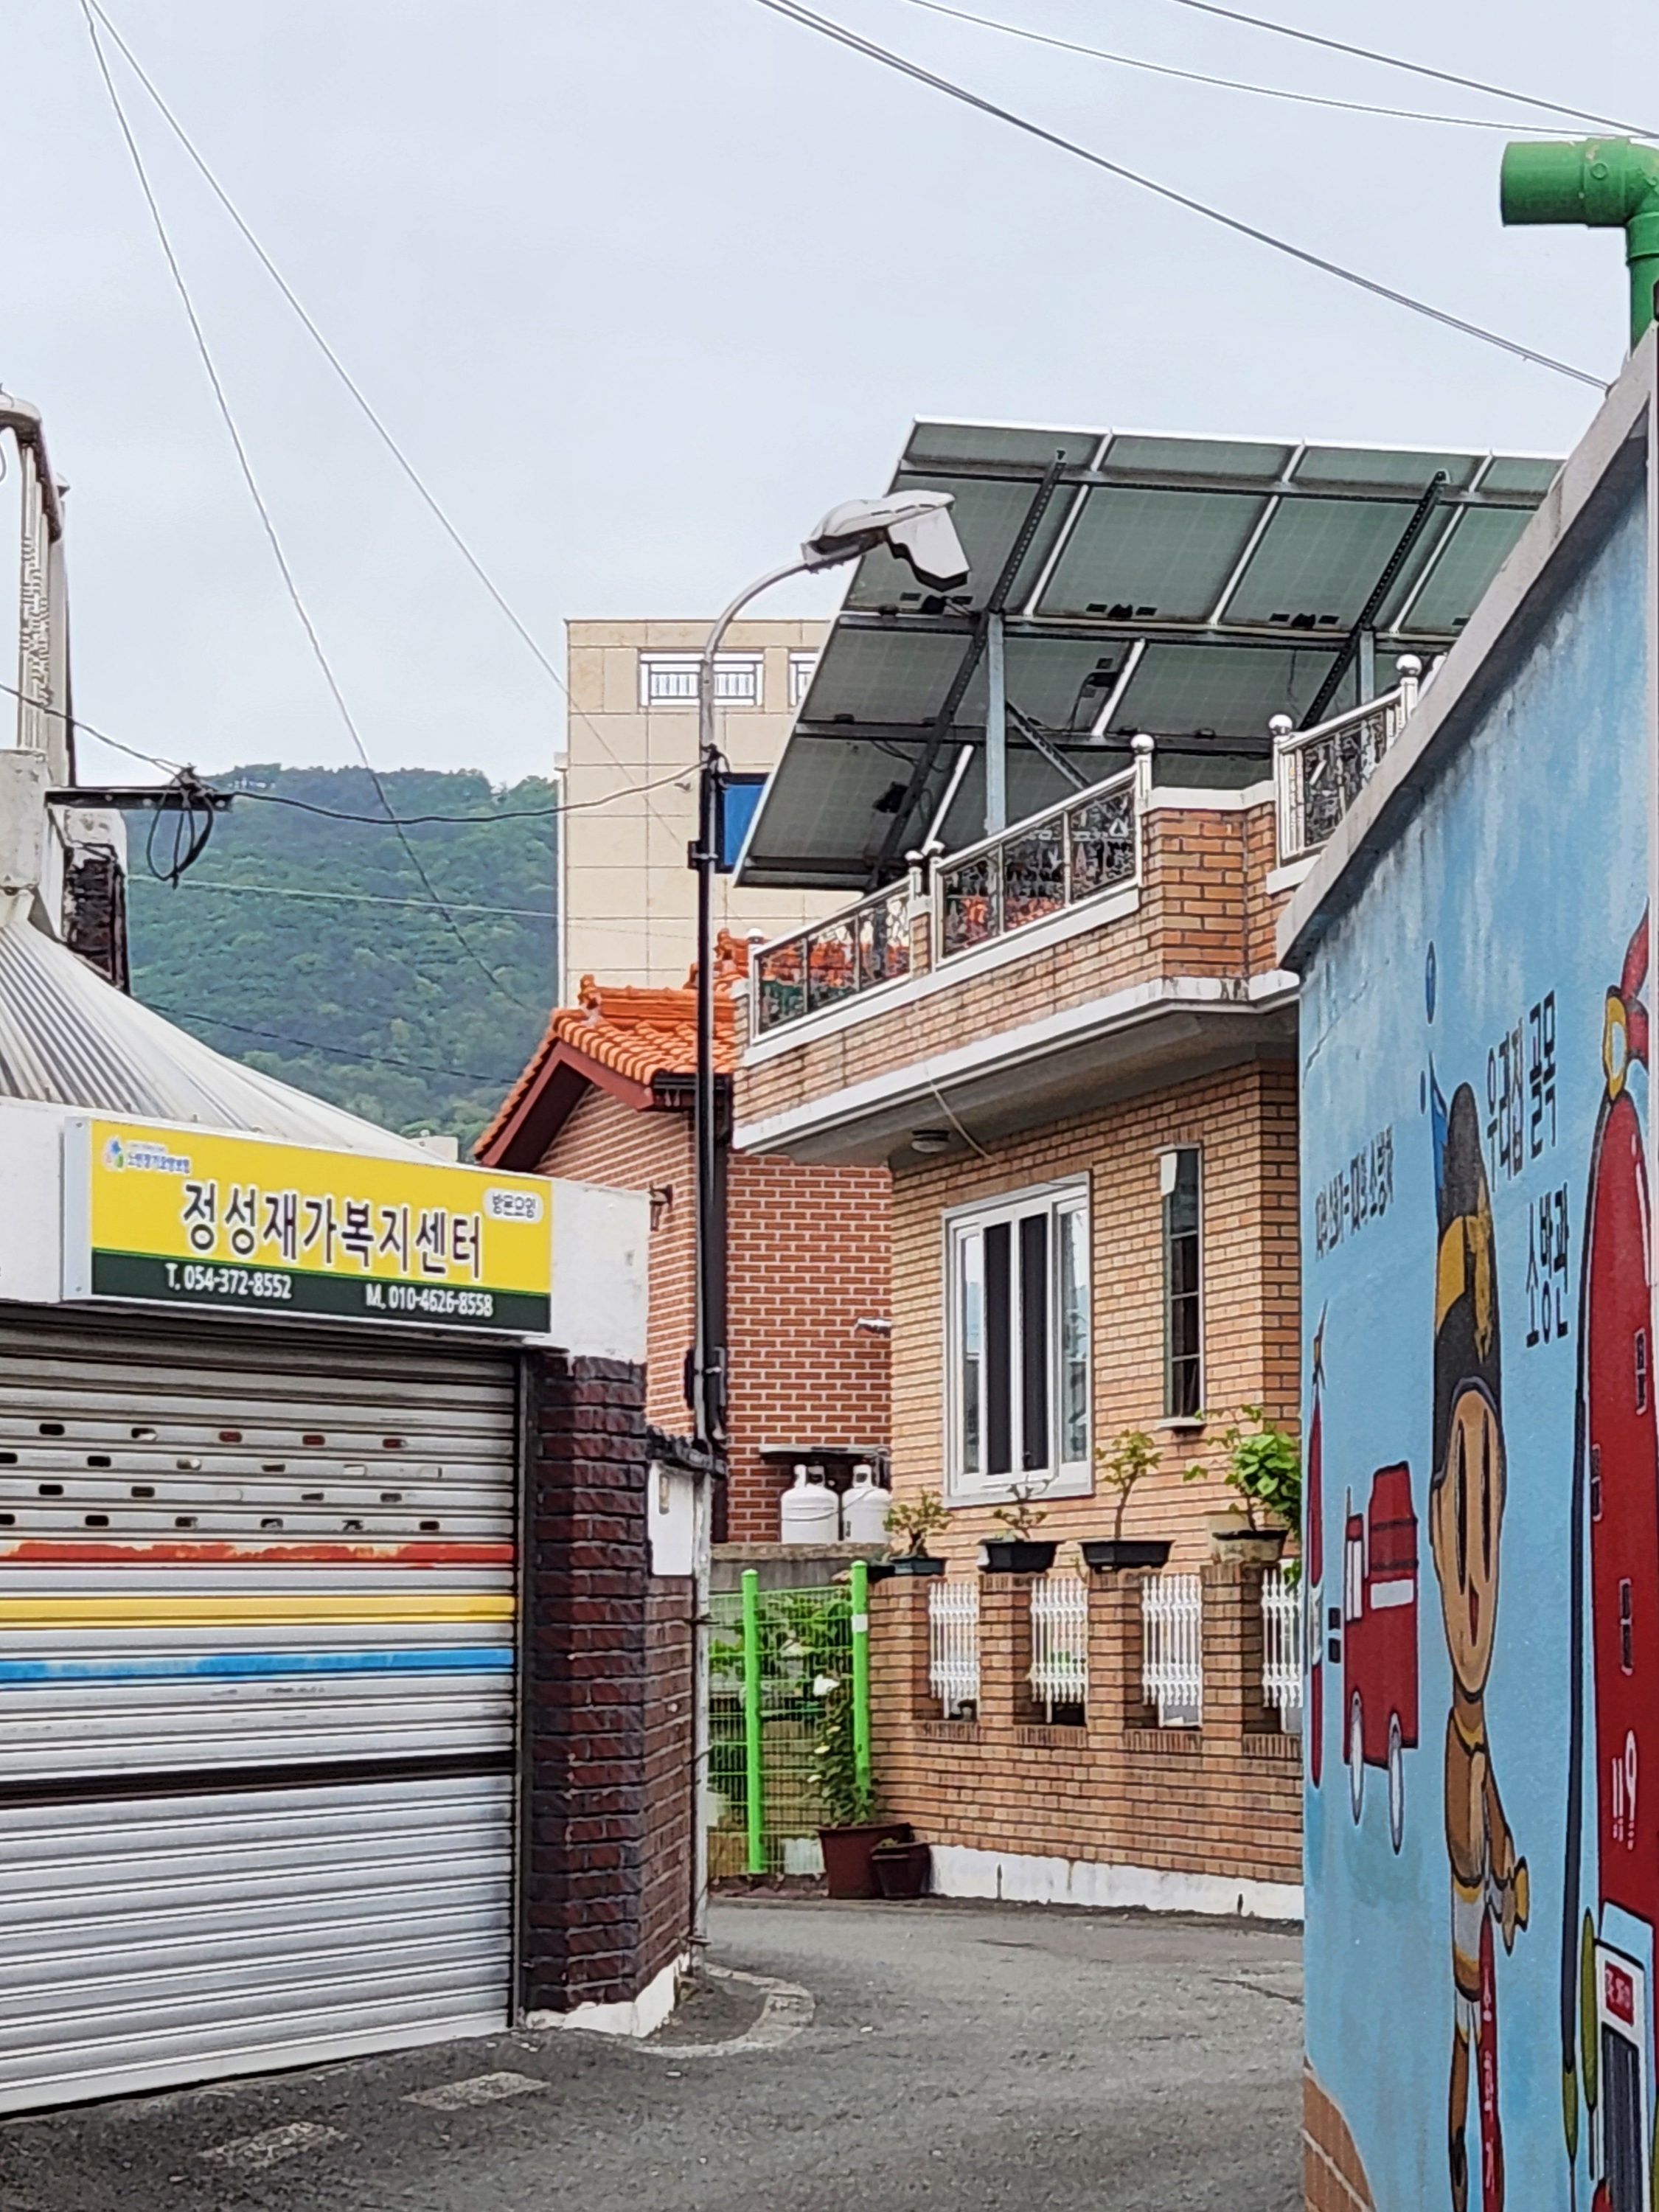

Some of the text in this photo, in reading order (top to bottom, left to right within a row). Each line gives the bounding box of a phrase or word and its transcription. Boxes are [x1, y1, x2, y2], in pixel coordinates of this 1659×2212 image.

[1487, 990, 1556, 1192] 우리집 골목
[184, 1183, 480, 1278] 정성재가복지센터
[492, 1194, 536, 1219] 방문요양
[1526, 1182, 1569, 1347] 소방관
